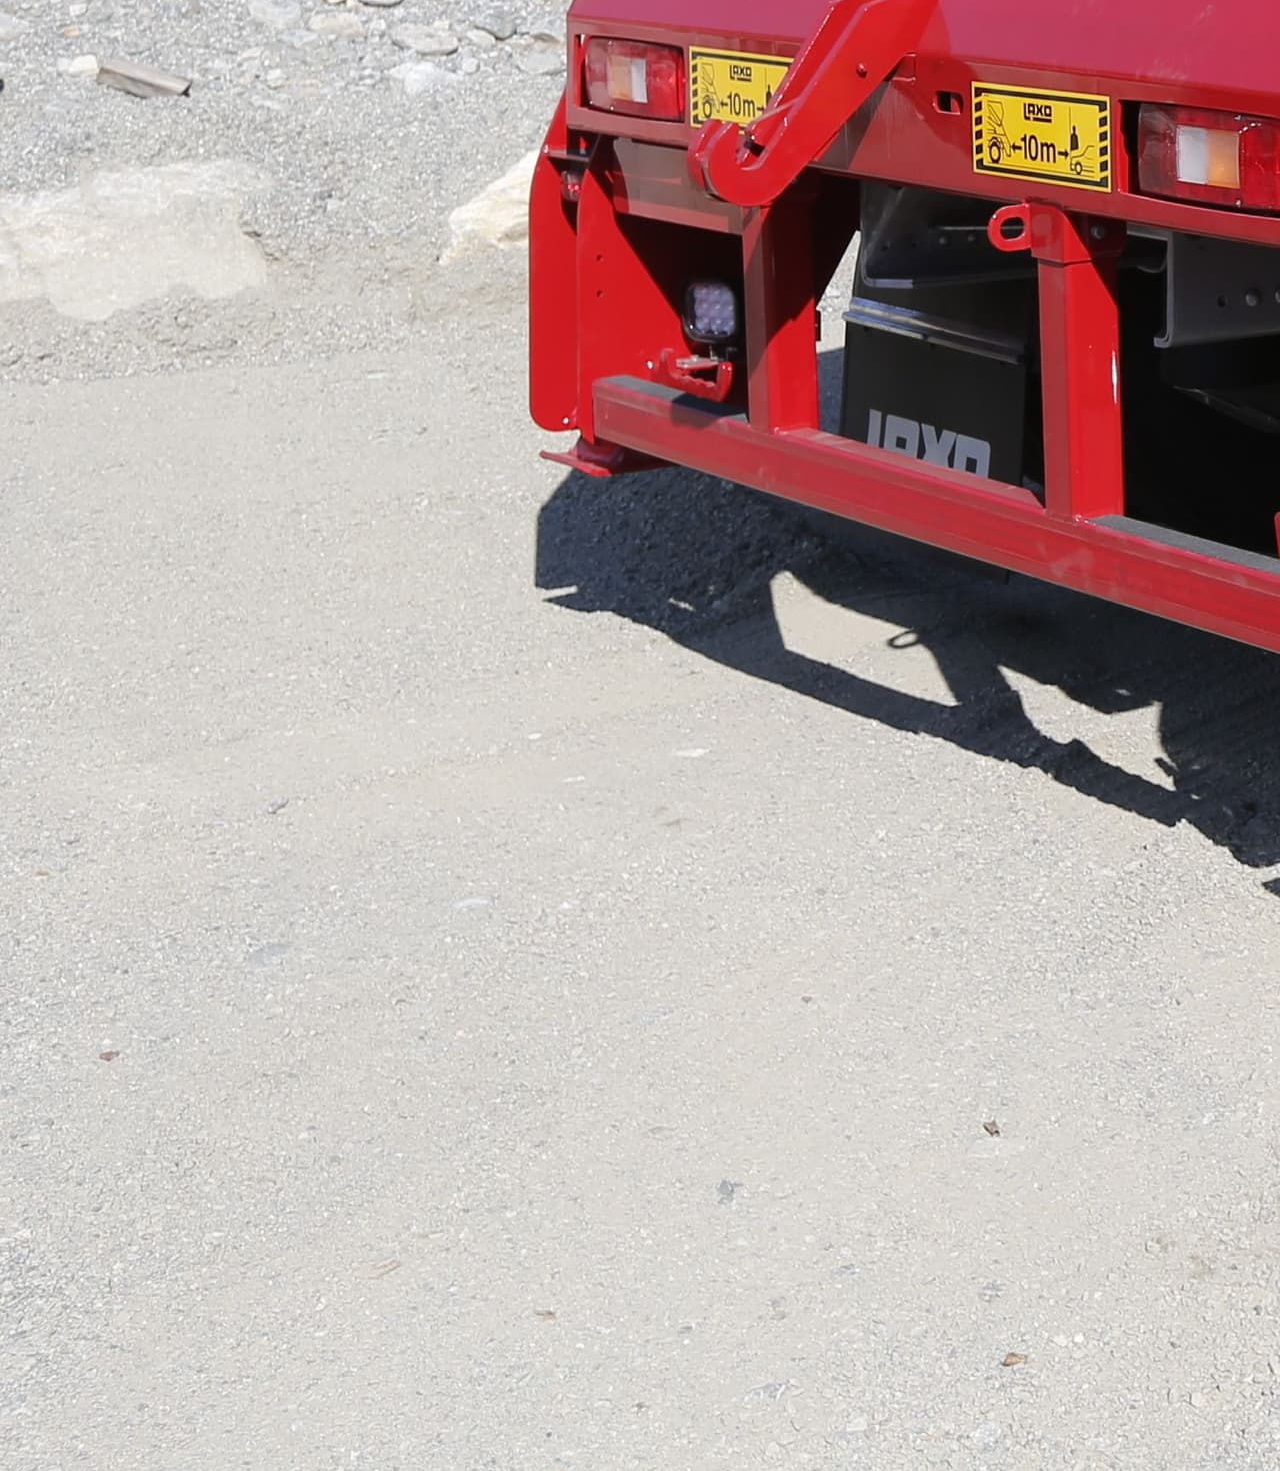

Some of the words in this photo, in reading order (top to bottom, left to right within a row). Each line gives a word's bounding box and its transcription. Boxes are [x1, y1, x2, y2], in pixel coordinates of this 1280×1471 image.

[729, 65, 752, 82] LAXO
[728, 91, 756, 118] 10m
[1023, 102, 1052, 123] LAXO
[1020, 134, 1056, 163] 10m
